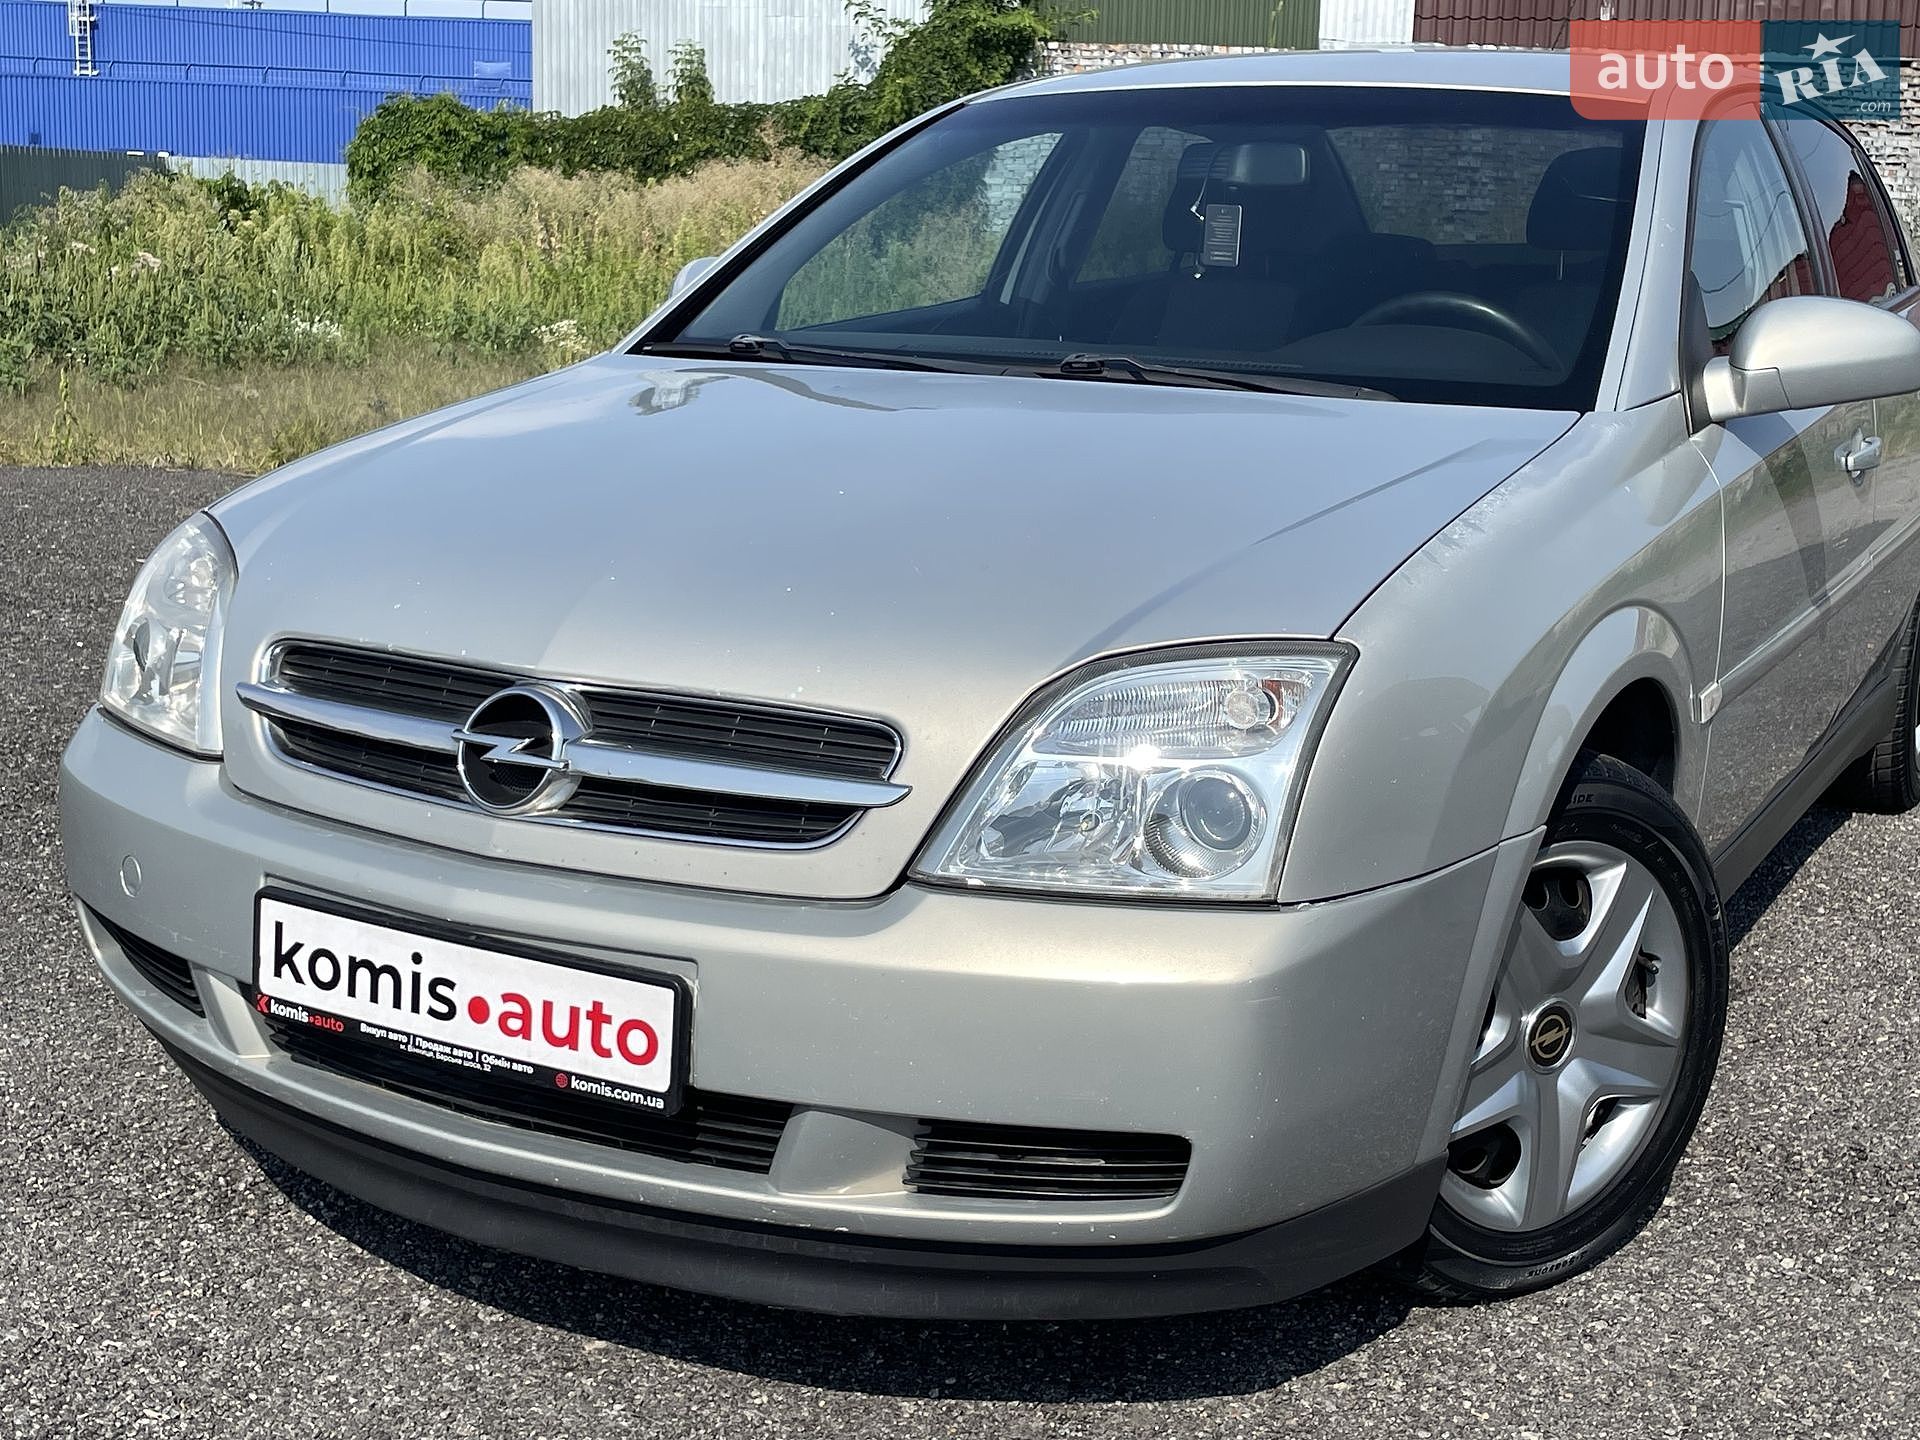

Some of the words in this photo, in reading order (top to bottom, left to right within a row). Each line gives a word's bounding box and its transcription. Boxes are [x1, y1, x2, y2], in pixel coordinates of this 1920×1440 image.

[360, 1023, 387, 1038] Викуп
[388, 1031, 408, 1043] авто
[415, 1036, 452, 1054] Продаж
[452, 1047, 474, 1060] авто
[481, 1053, 511, 1069] Обмін
[512, 1061, 534, 1074] авто
[571, 1075, 665, 1109] komis.com.ua
